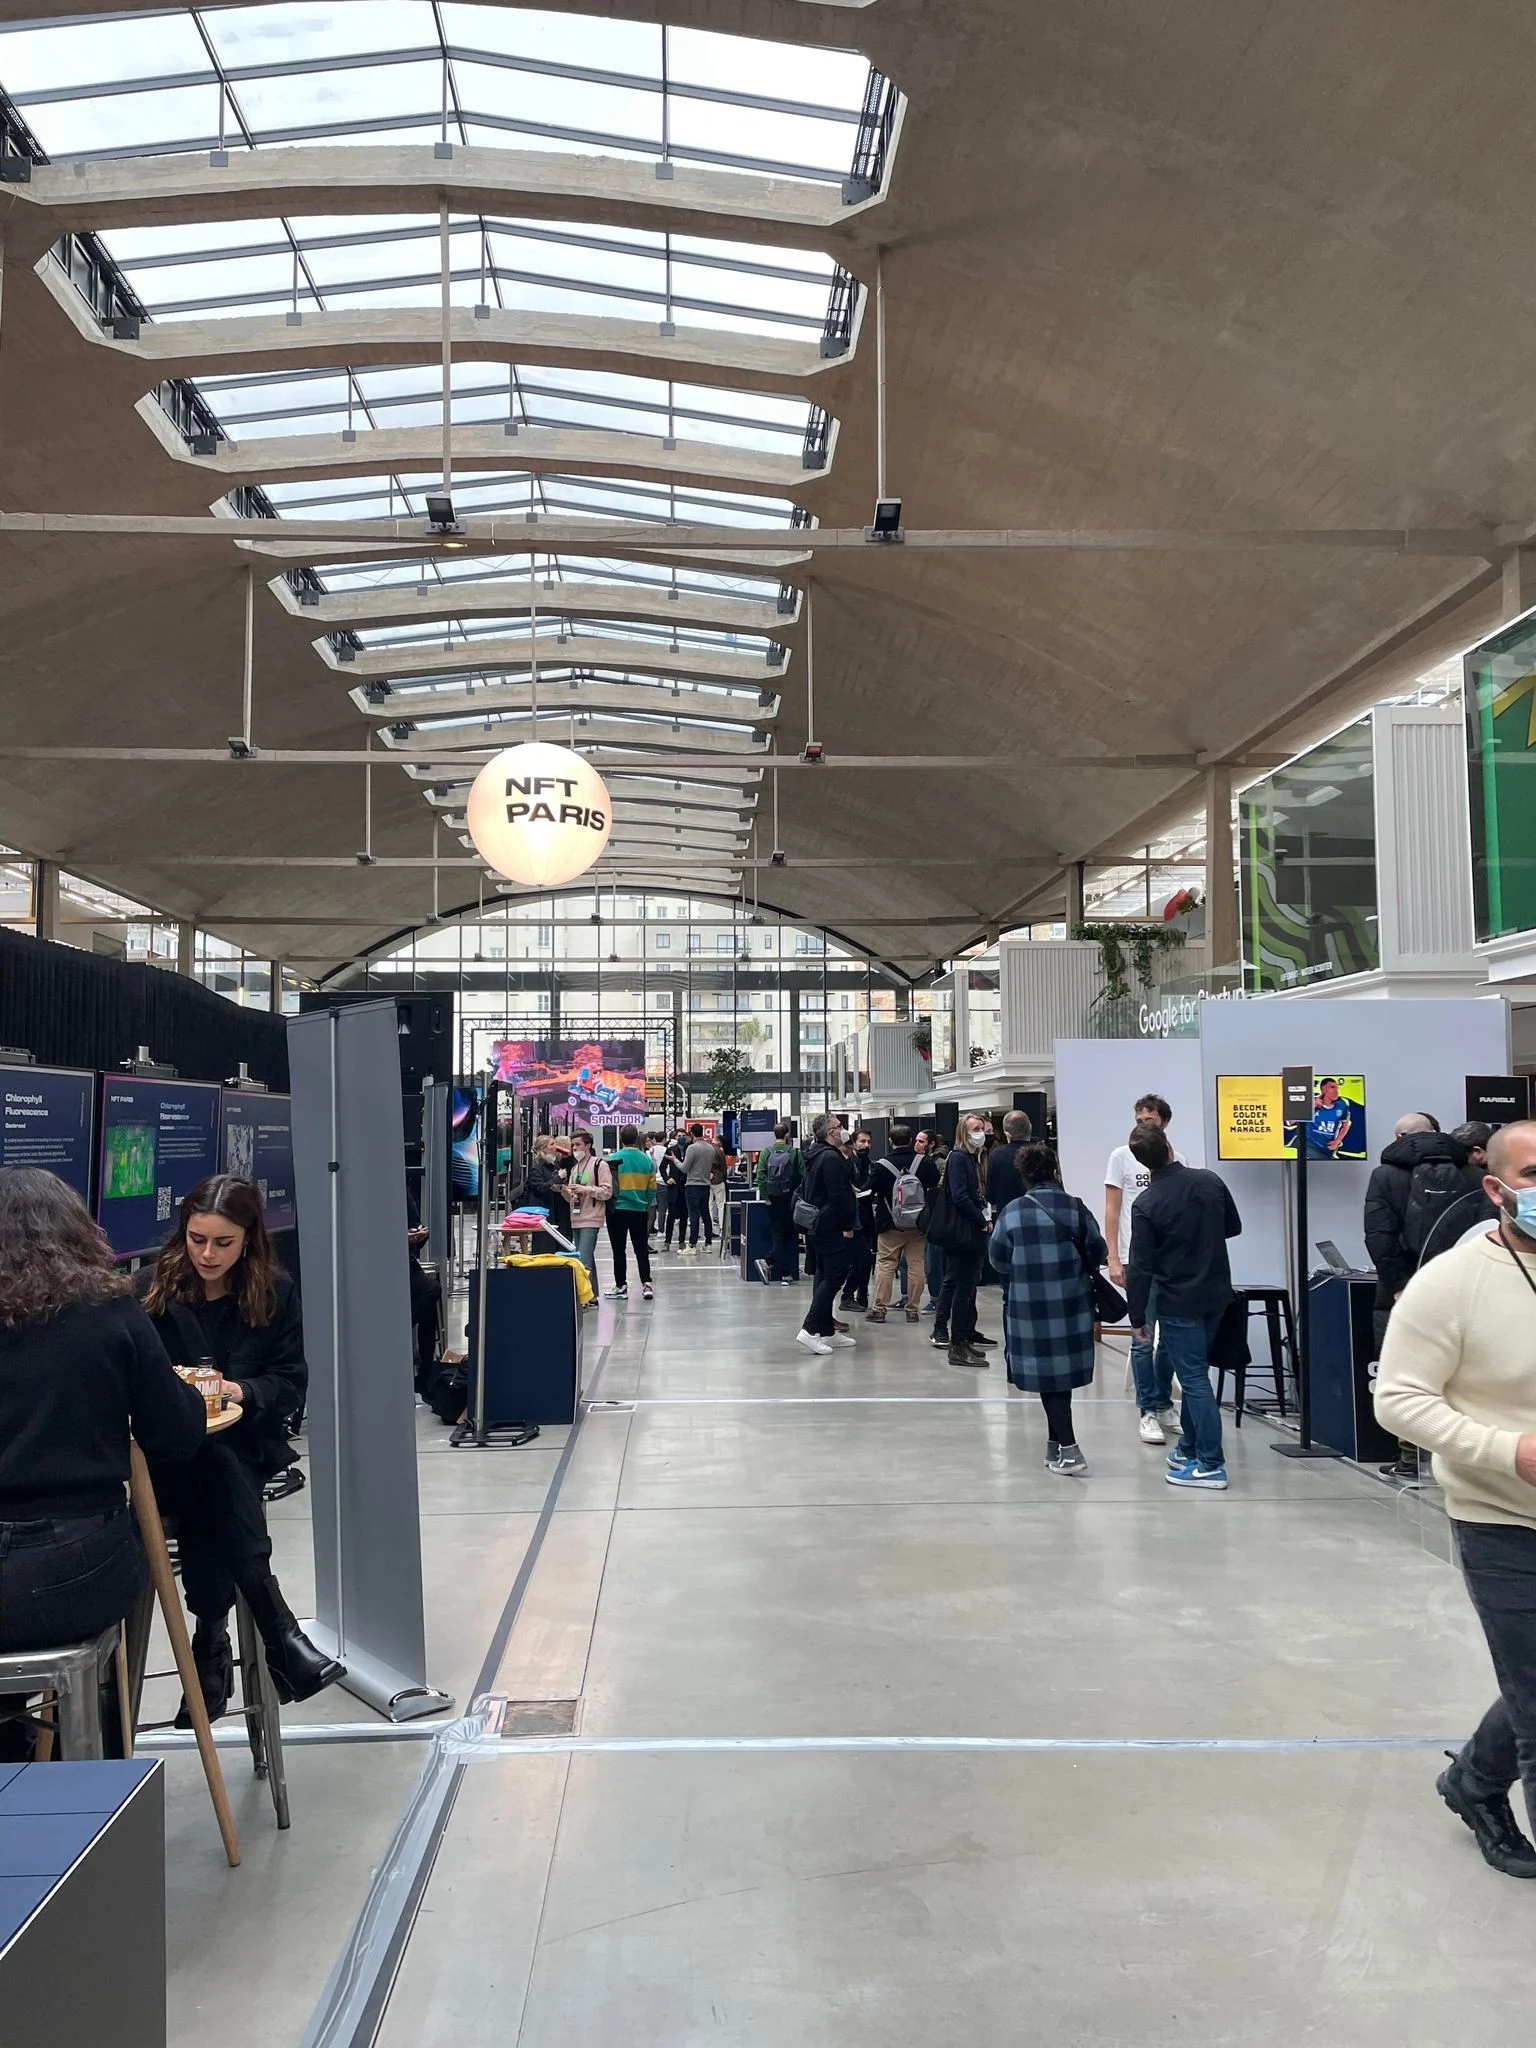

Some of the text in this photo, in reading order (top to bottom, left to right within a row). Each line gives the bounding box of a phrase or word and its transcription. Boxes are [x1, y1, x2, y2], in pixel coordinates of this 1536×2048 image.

[505, 777, 578, 797] NFT
[506, 802, 605, 831] PARIS
[1139, 1004, 1178, 1037] Google
[1180, 995, 1197, 1024] for
[5, 1093, 43, 1104] Chlorophyll
[5, 1106, 49, 1116] Fluorescence
[591, 1114, 643, 1126] SANDBOX
